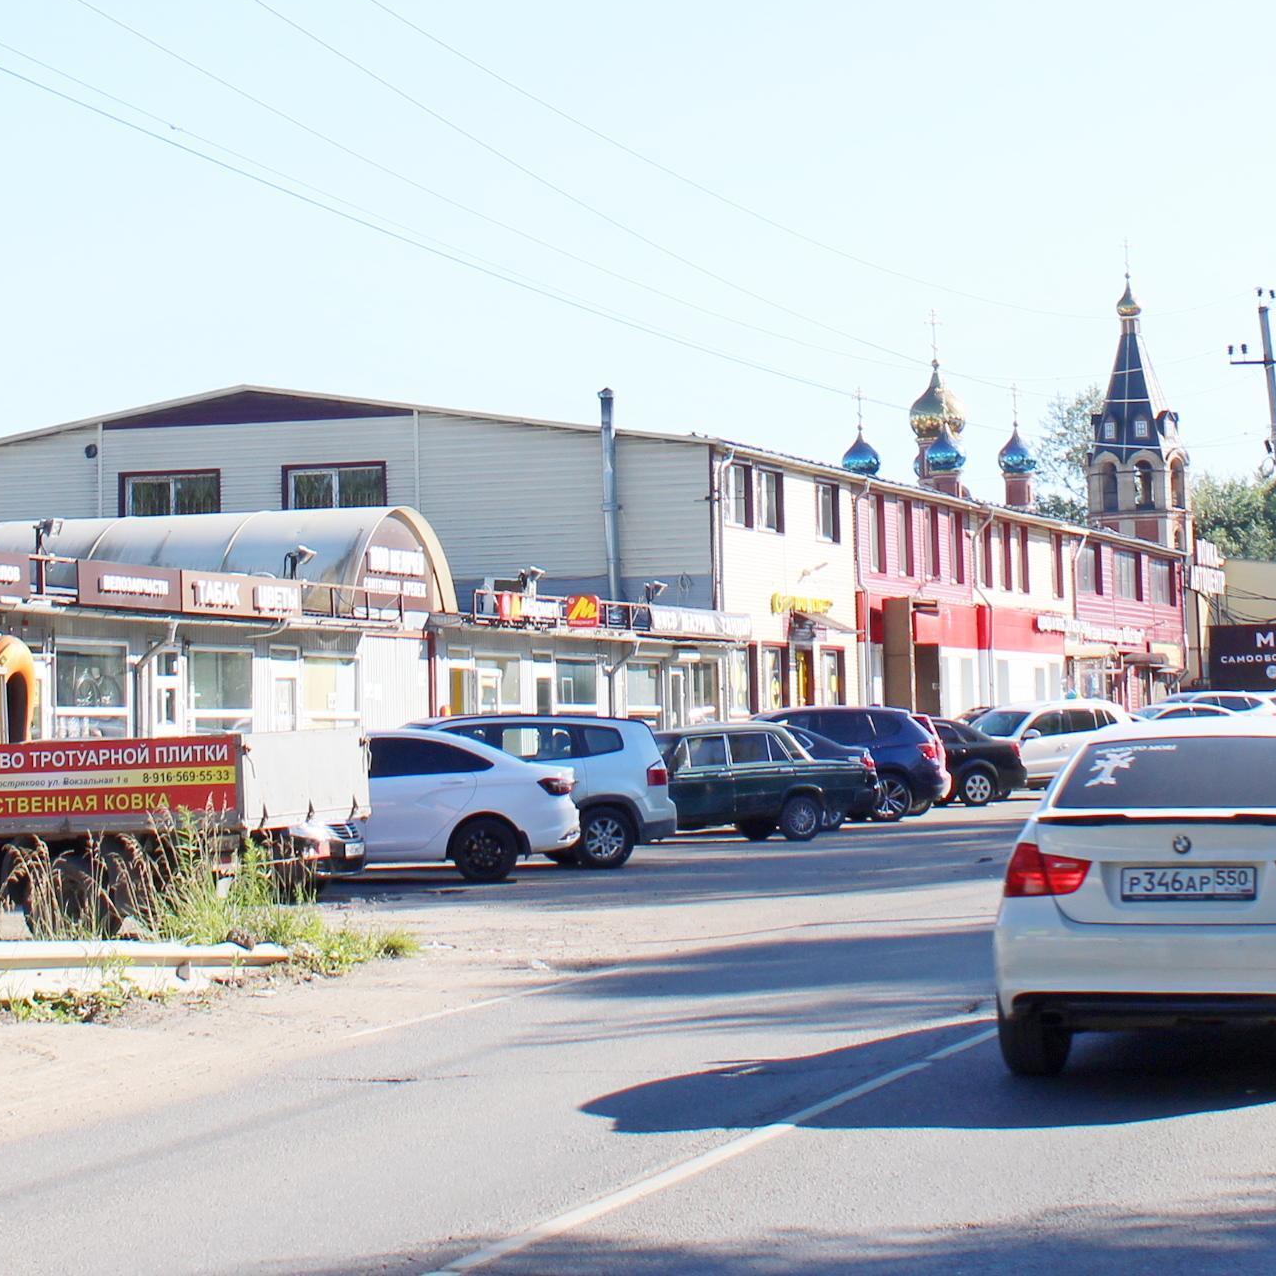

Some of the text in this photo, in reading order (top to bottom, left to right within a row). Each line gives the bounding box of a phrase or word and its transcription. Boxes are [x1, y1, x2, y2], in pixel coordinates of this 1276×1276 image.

[197, 580, 299, 610] ТАБАК ЦВЕТЫ
[29, 743, 150, 769] ТРОТУАРНОЙ
[155, 744, 228, 764] ПЛИТКИ
[46, 777, 61, 789] ул.
[63, 776, 113, 786] Вокзальная
[142, 770, 230, 784] 8-916-569-55-33
[104, 792, 170, 811] КОВКА
[1215, 870, 1248, 886] 550
